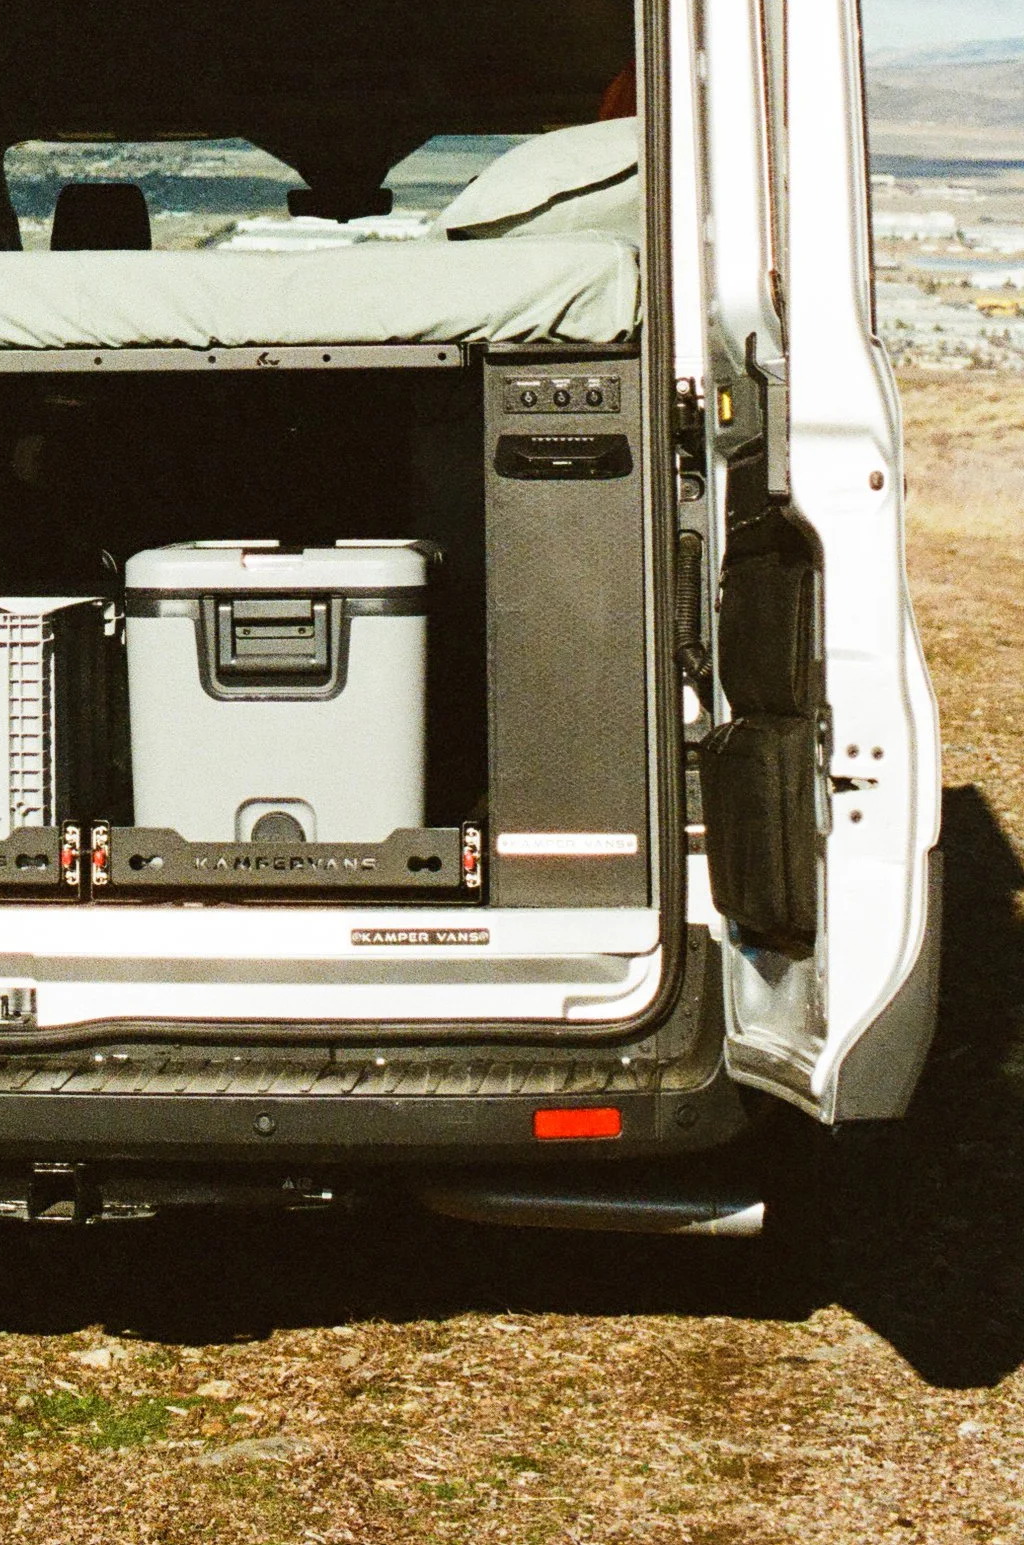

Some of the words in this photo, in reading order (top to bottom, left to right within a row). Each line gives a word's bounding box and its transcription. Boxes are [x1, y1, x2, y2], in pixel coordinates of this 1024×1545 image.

[194, 856, 377, 871] KAMPERVANS
[362, 931, 429, 942] KAMPER
[436, 931, 477, 942] VANS
